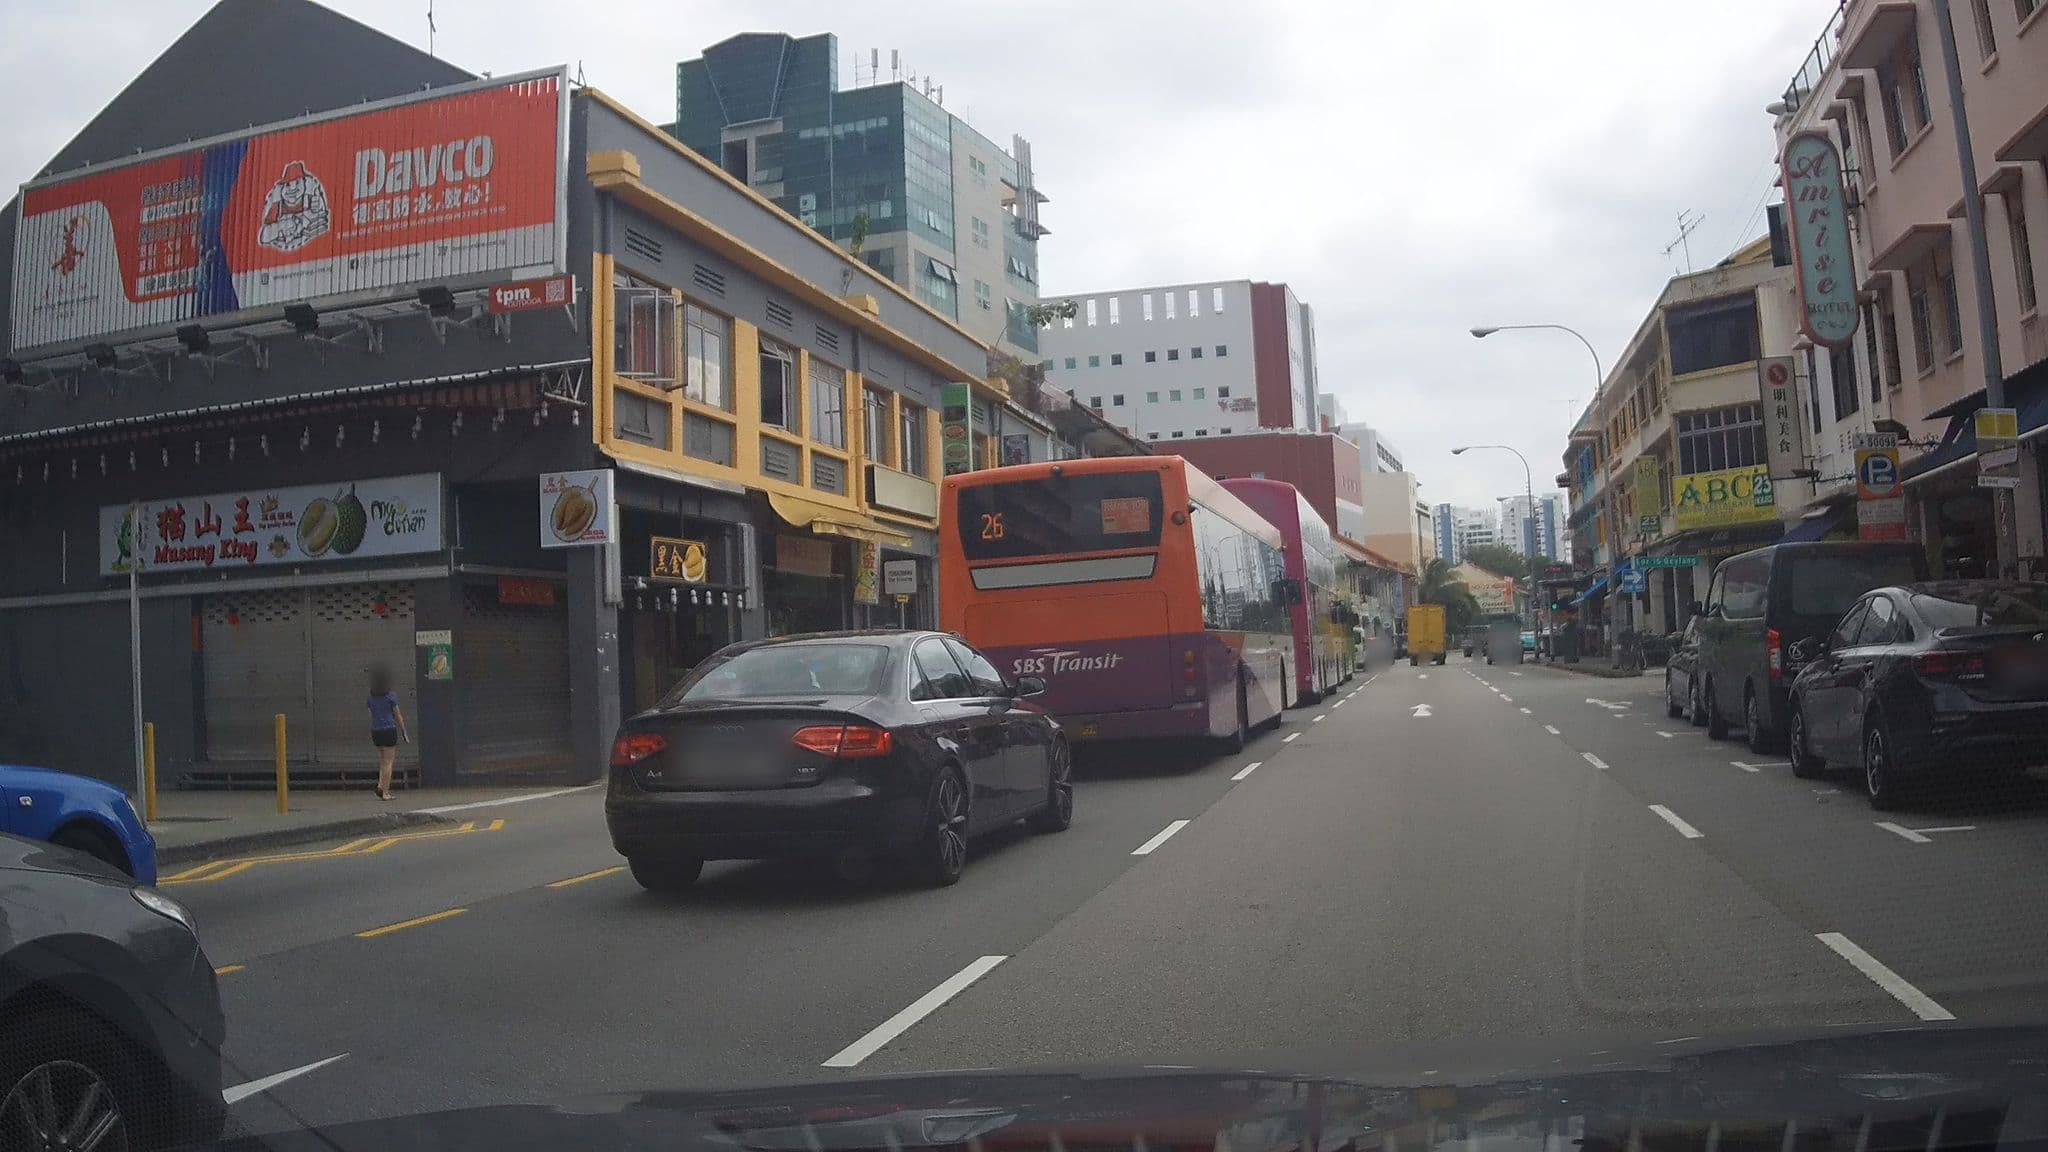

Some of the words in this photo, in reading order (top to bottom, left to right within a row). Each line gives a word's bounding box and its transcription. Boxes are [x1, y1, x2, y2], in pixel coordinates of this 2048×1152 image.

[354, 135, 493, 199] Davco
[1788, 151, 1837, 295] Amrise
[496, 287, 530, 305] tpm
[1773, 388, 1791, 453] 明利美食
[1679, 474, 1751, 505] ABC
[981, 513, 1004, 540] 26
[153, 543, 215, 566] Musang
[220, 538, 258, 564] King
[656, 545, 684, 575] 黑金
[1013, 658, 1045, 675] SBS
[1044, 650, 1123, 675] Transit
